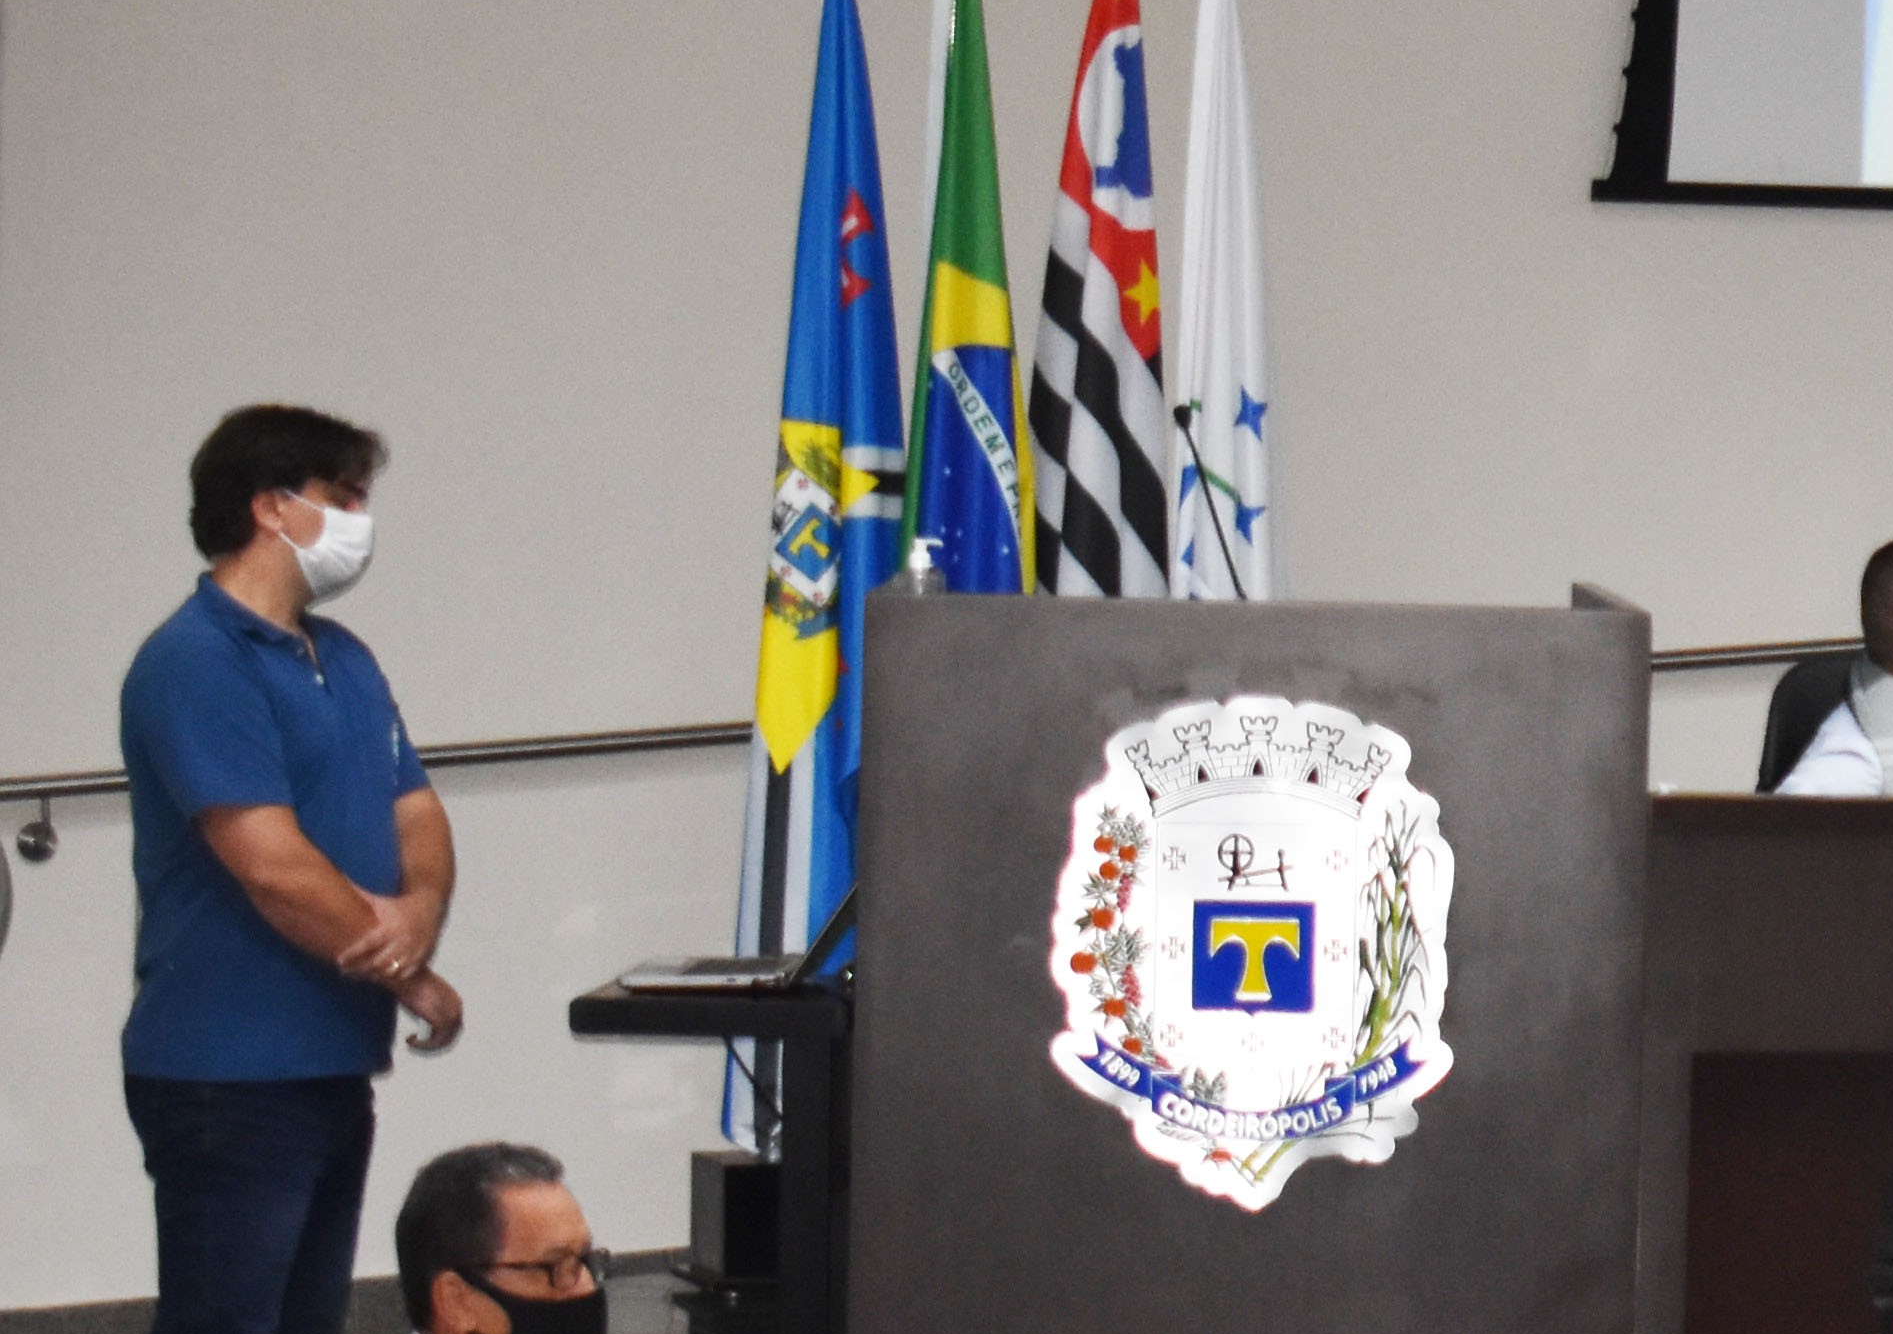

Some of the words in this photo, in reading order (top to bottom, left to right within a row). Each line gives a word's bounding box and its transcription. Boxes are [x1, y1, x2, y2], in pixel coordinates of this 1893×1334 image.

[948, 362, 1006, 454] ORDEM
[1210, 917, 1300, 1002] T
[1100, 1050, 1141, 1088] 1899
[1160, 1091, 1343, 1141] CORDEIRÓPOLIS
